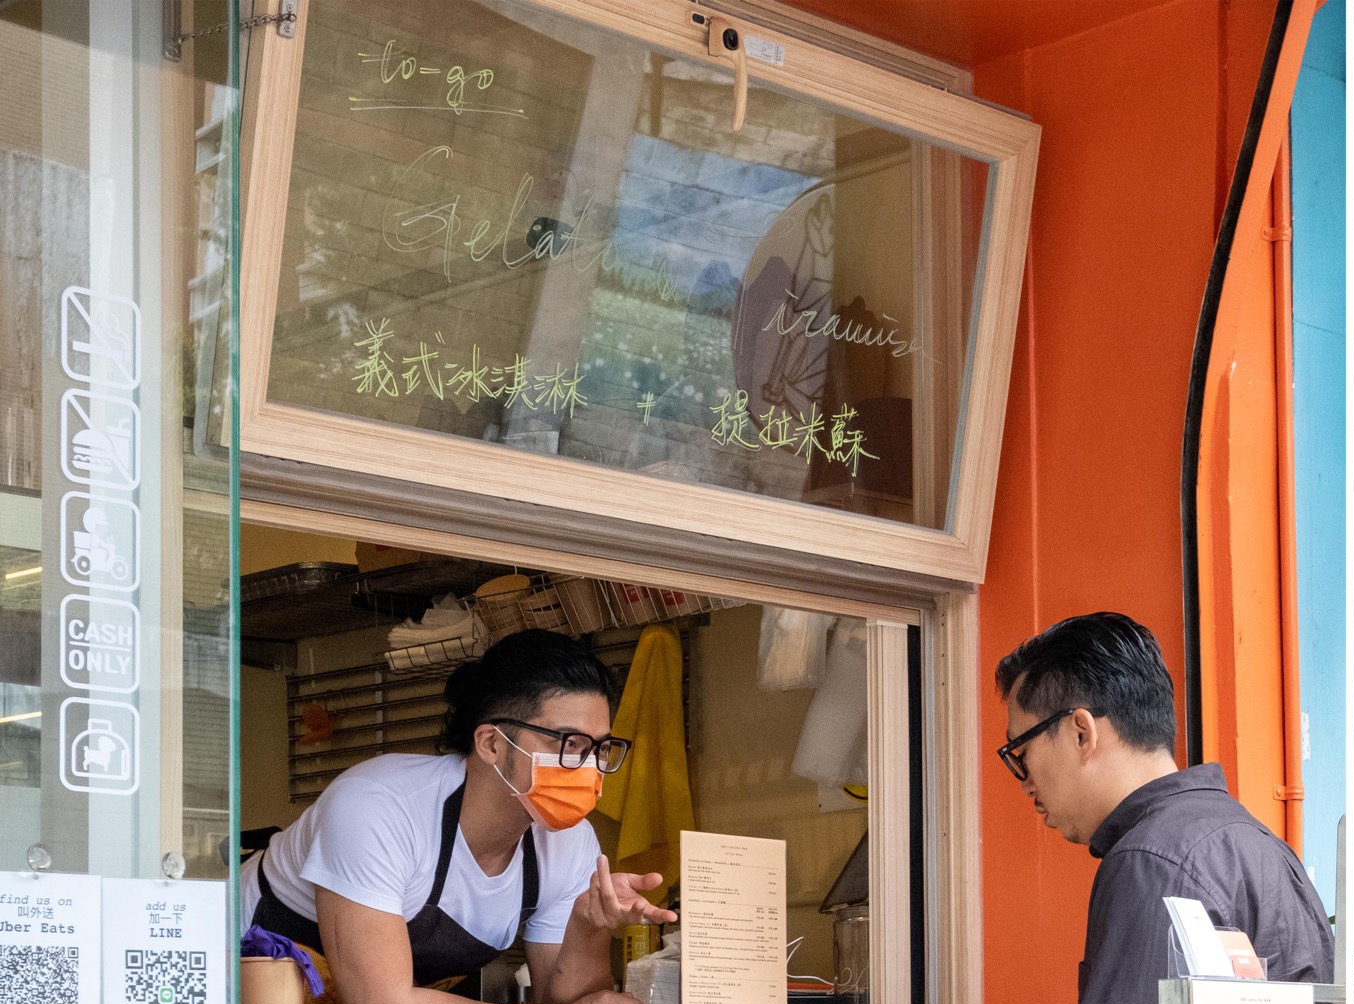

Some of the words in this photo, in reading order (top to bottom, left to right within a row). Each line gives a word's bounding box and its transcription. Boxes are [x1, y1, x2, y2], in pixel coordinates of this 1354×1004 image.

[358, 39, 495, 114] to-go
[382, 145, 619, 283] Gelato
[352, 317, 588, 419] 義式冰淇淋
[709, 389, 881, 477] 提拉米蘇
[68, 618, 133, 646] CASH
[68, 649, 131, 676] ONLY
[0, 894, 29, 904] find
[36, 897, 50, 905] us
[58, 898, 72, 906] on
[145, 901, 167, 911] add
[173, 904, 186, 912] us
[17, 906, 54, 919] 叫外送
[149, 911, 183, 925] 加一下
[40, 922, 75, 934] Eats
[149, 927, 182, 938] LINE
